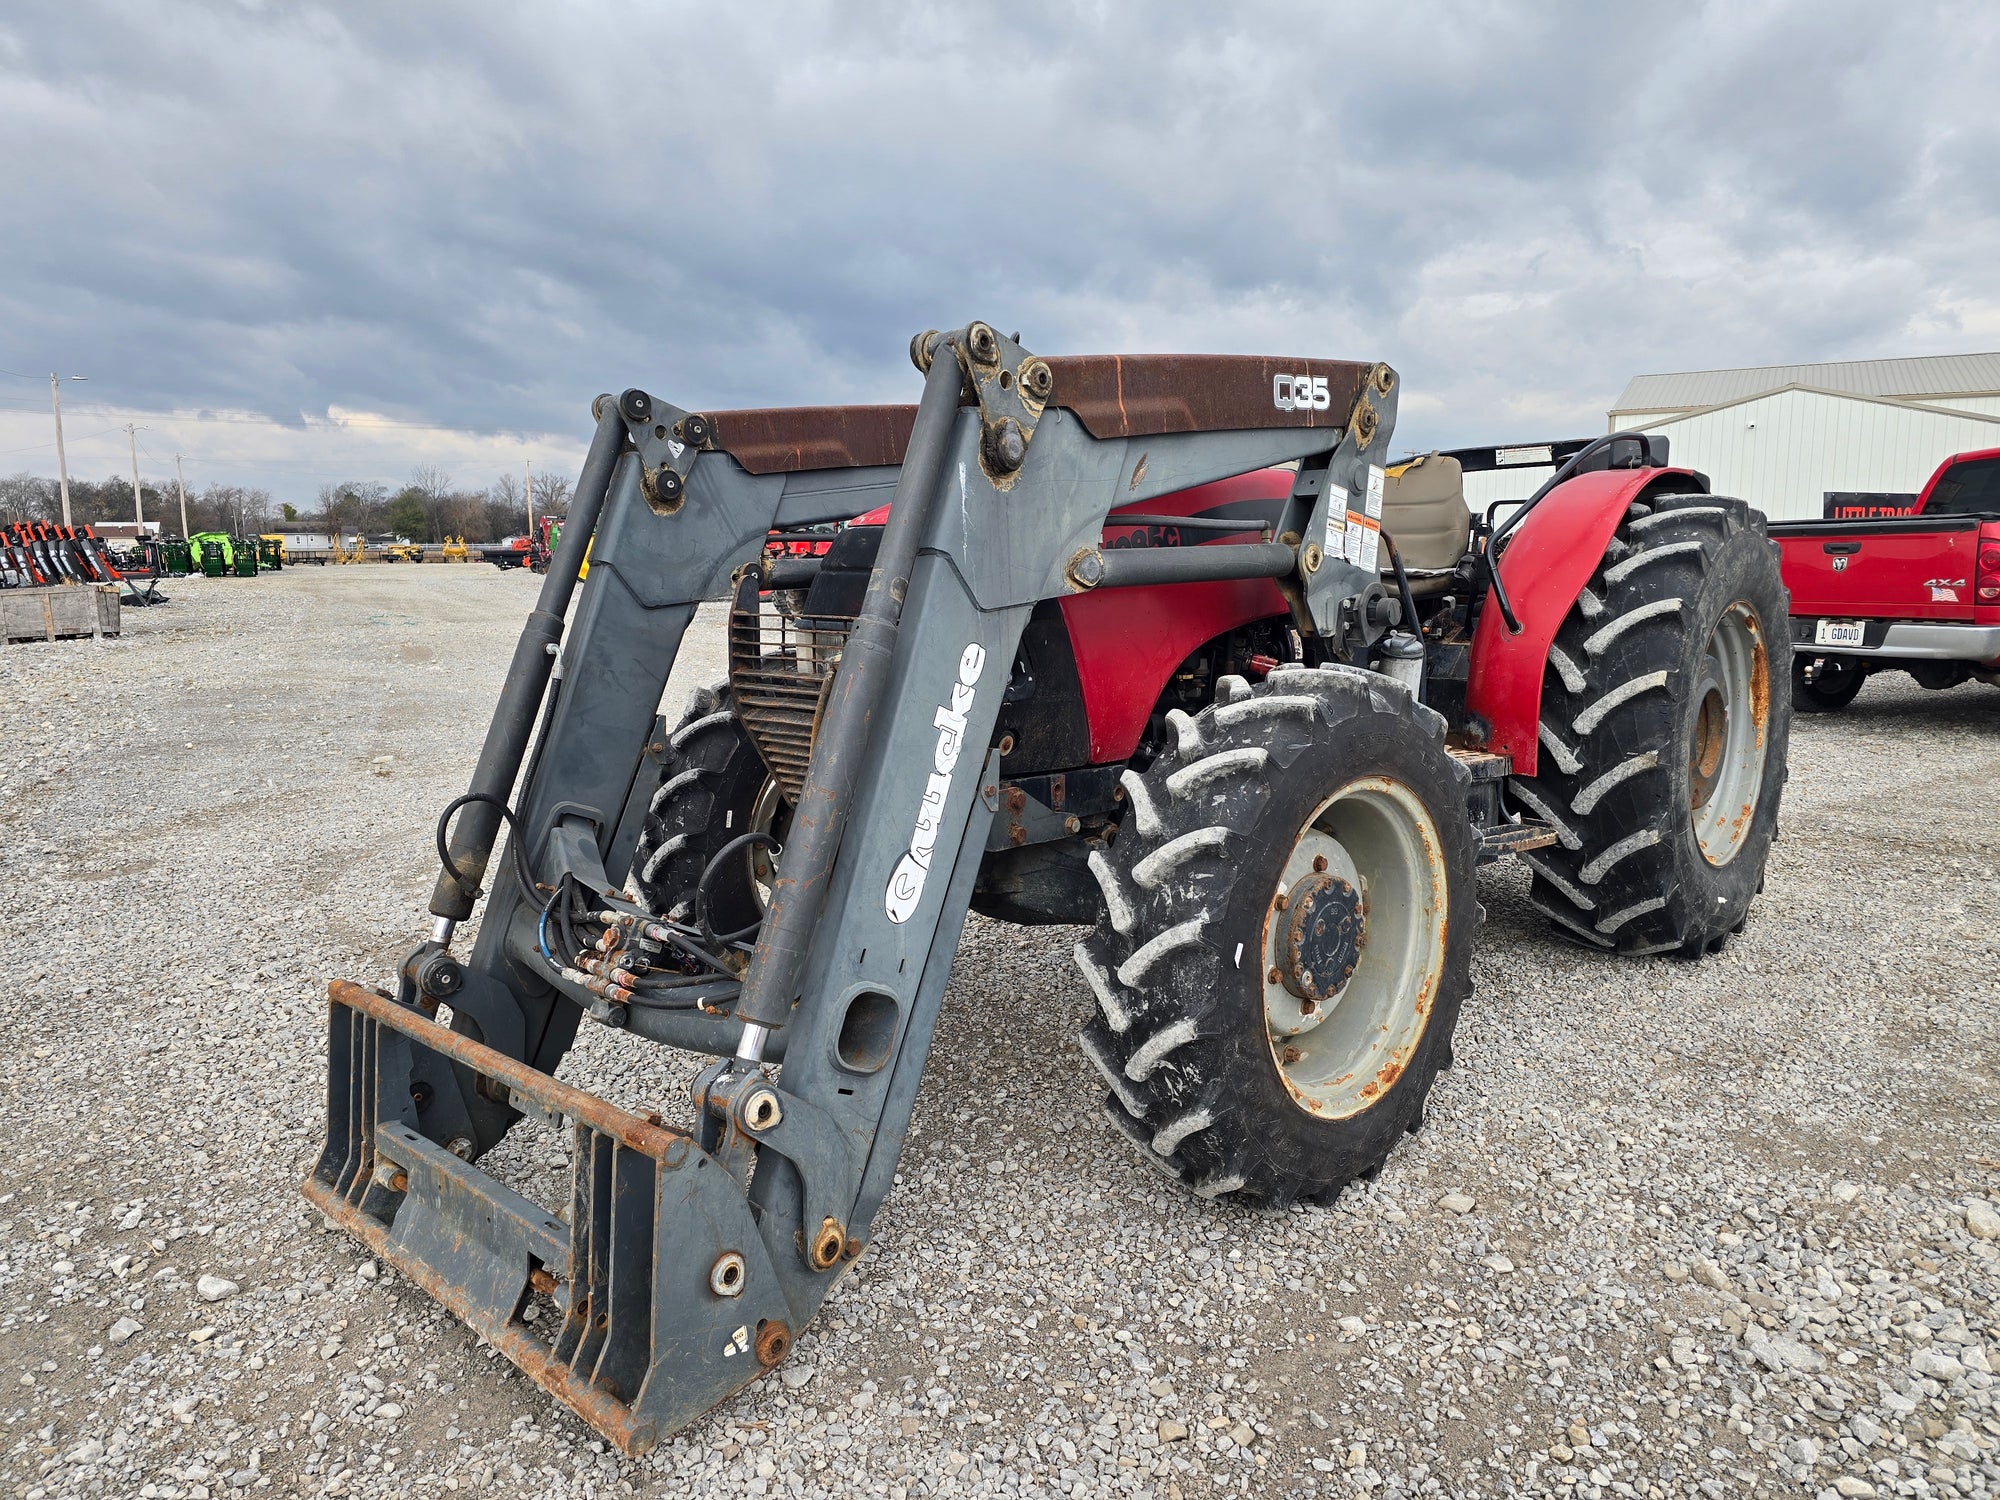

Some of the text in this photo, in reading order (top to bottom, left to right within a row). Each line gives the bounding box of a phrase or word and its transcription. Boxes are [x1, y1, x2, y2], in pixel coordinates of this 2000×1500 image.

[1274, 374, 1330, 411] Q35
[1820, 627, 1859, 640] 1 GDAVD
[884, 642, 987, 924] Quicke
